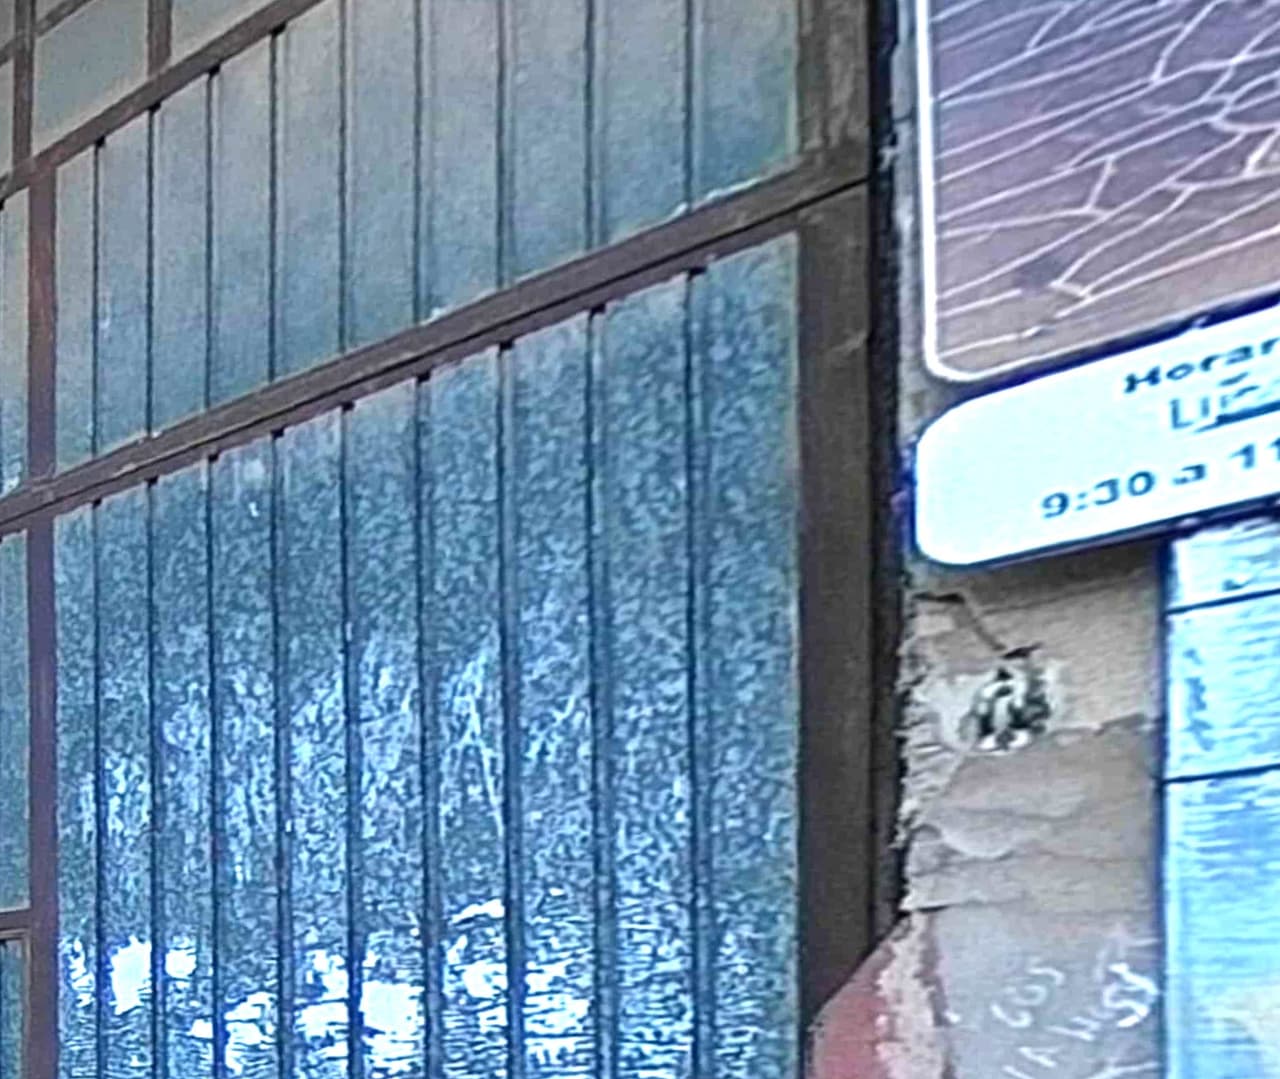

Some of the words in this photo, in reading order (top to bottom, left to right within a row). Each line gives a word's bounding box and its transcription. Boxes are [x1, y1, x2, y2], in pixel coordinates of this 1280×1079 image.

[1124, 337, 1280, 393] Horar
[1041, 470, 1156, 519] 9:30
[1173, 463, 1206, 485] a
